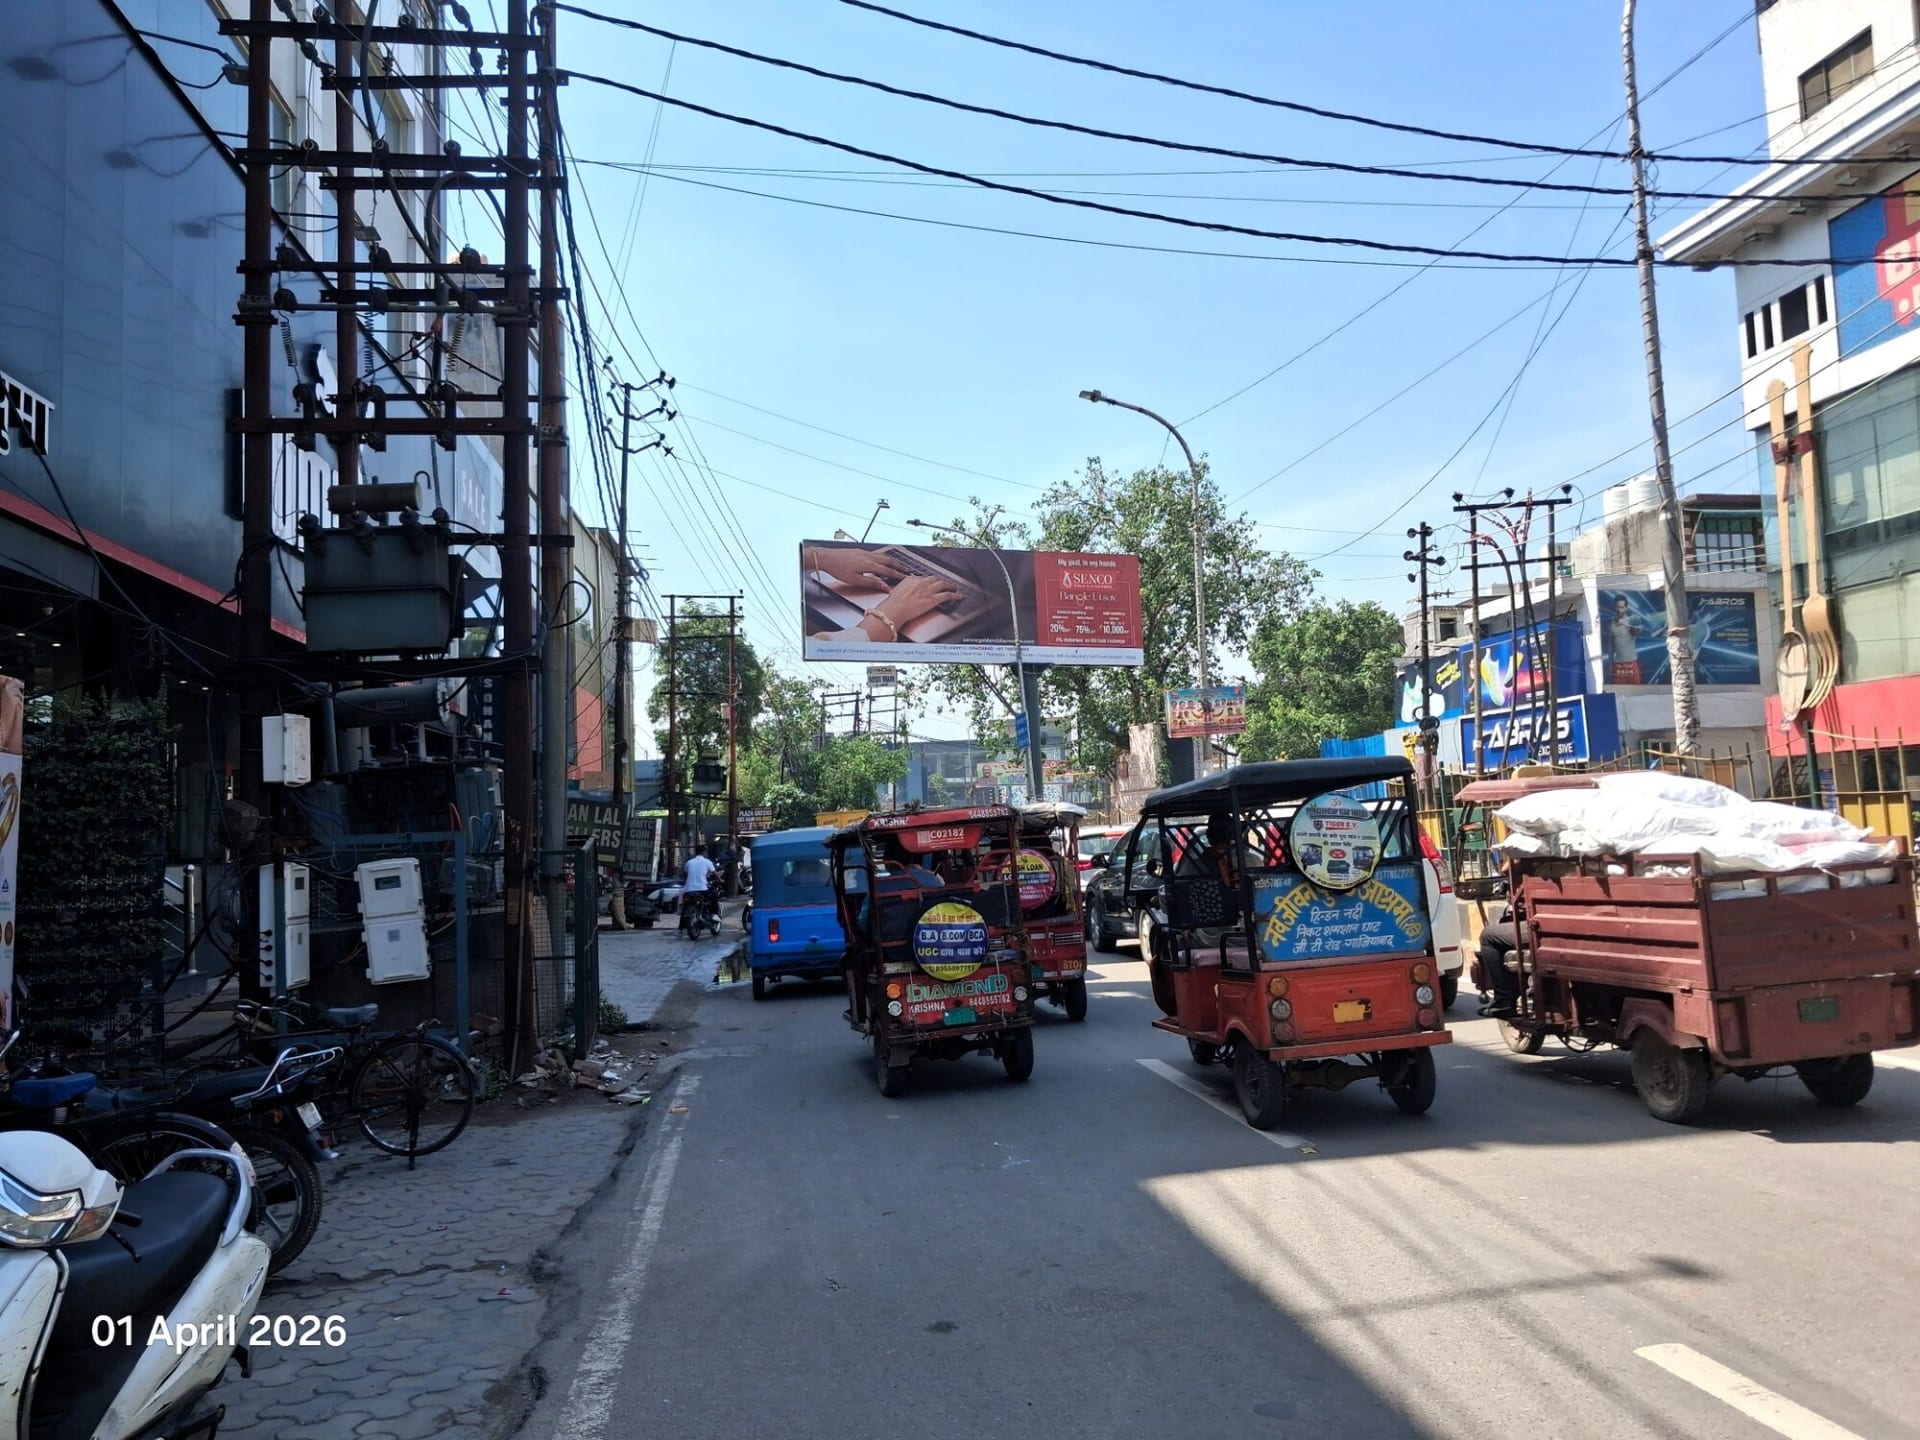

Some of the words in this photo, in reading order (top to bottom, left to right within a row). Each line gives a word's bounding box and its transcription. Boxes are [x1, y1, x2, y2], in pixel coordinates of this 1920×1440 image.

[462, 469, 486, 526] SALE
[1058, 558, 1067, 567] My
[1089, 560, 1098, 568] my
[1099, 560, 1116, 568] hands
[1073, 573, 1113, 585] SENCO
[1704, 598, 1746, 606] ABROS
[1487, 709, 1573, 749] ABROS
[1537, 742, 1574, 757] EXCSIVE
[567, 803, 589, 822] AN
[594, 806, 621, 826] LAL
[630, 829, 650, 839] COIN
[1343, 902, 1364, 920] नदी
[921, 932, 936, 940] B.A
[1296, 924, 1323, 940] निकट
[1325, 939, 1340, 950] रोड
[918, 947, 938, 956] UGC
[906, 974, 1008, 1003] DIAMOND
[909, 1002, 946, 1014] KRISHNA
